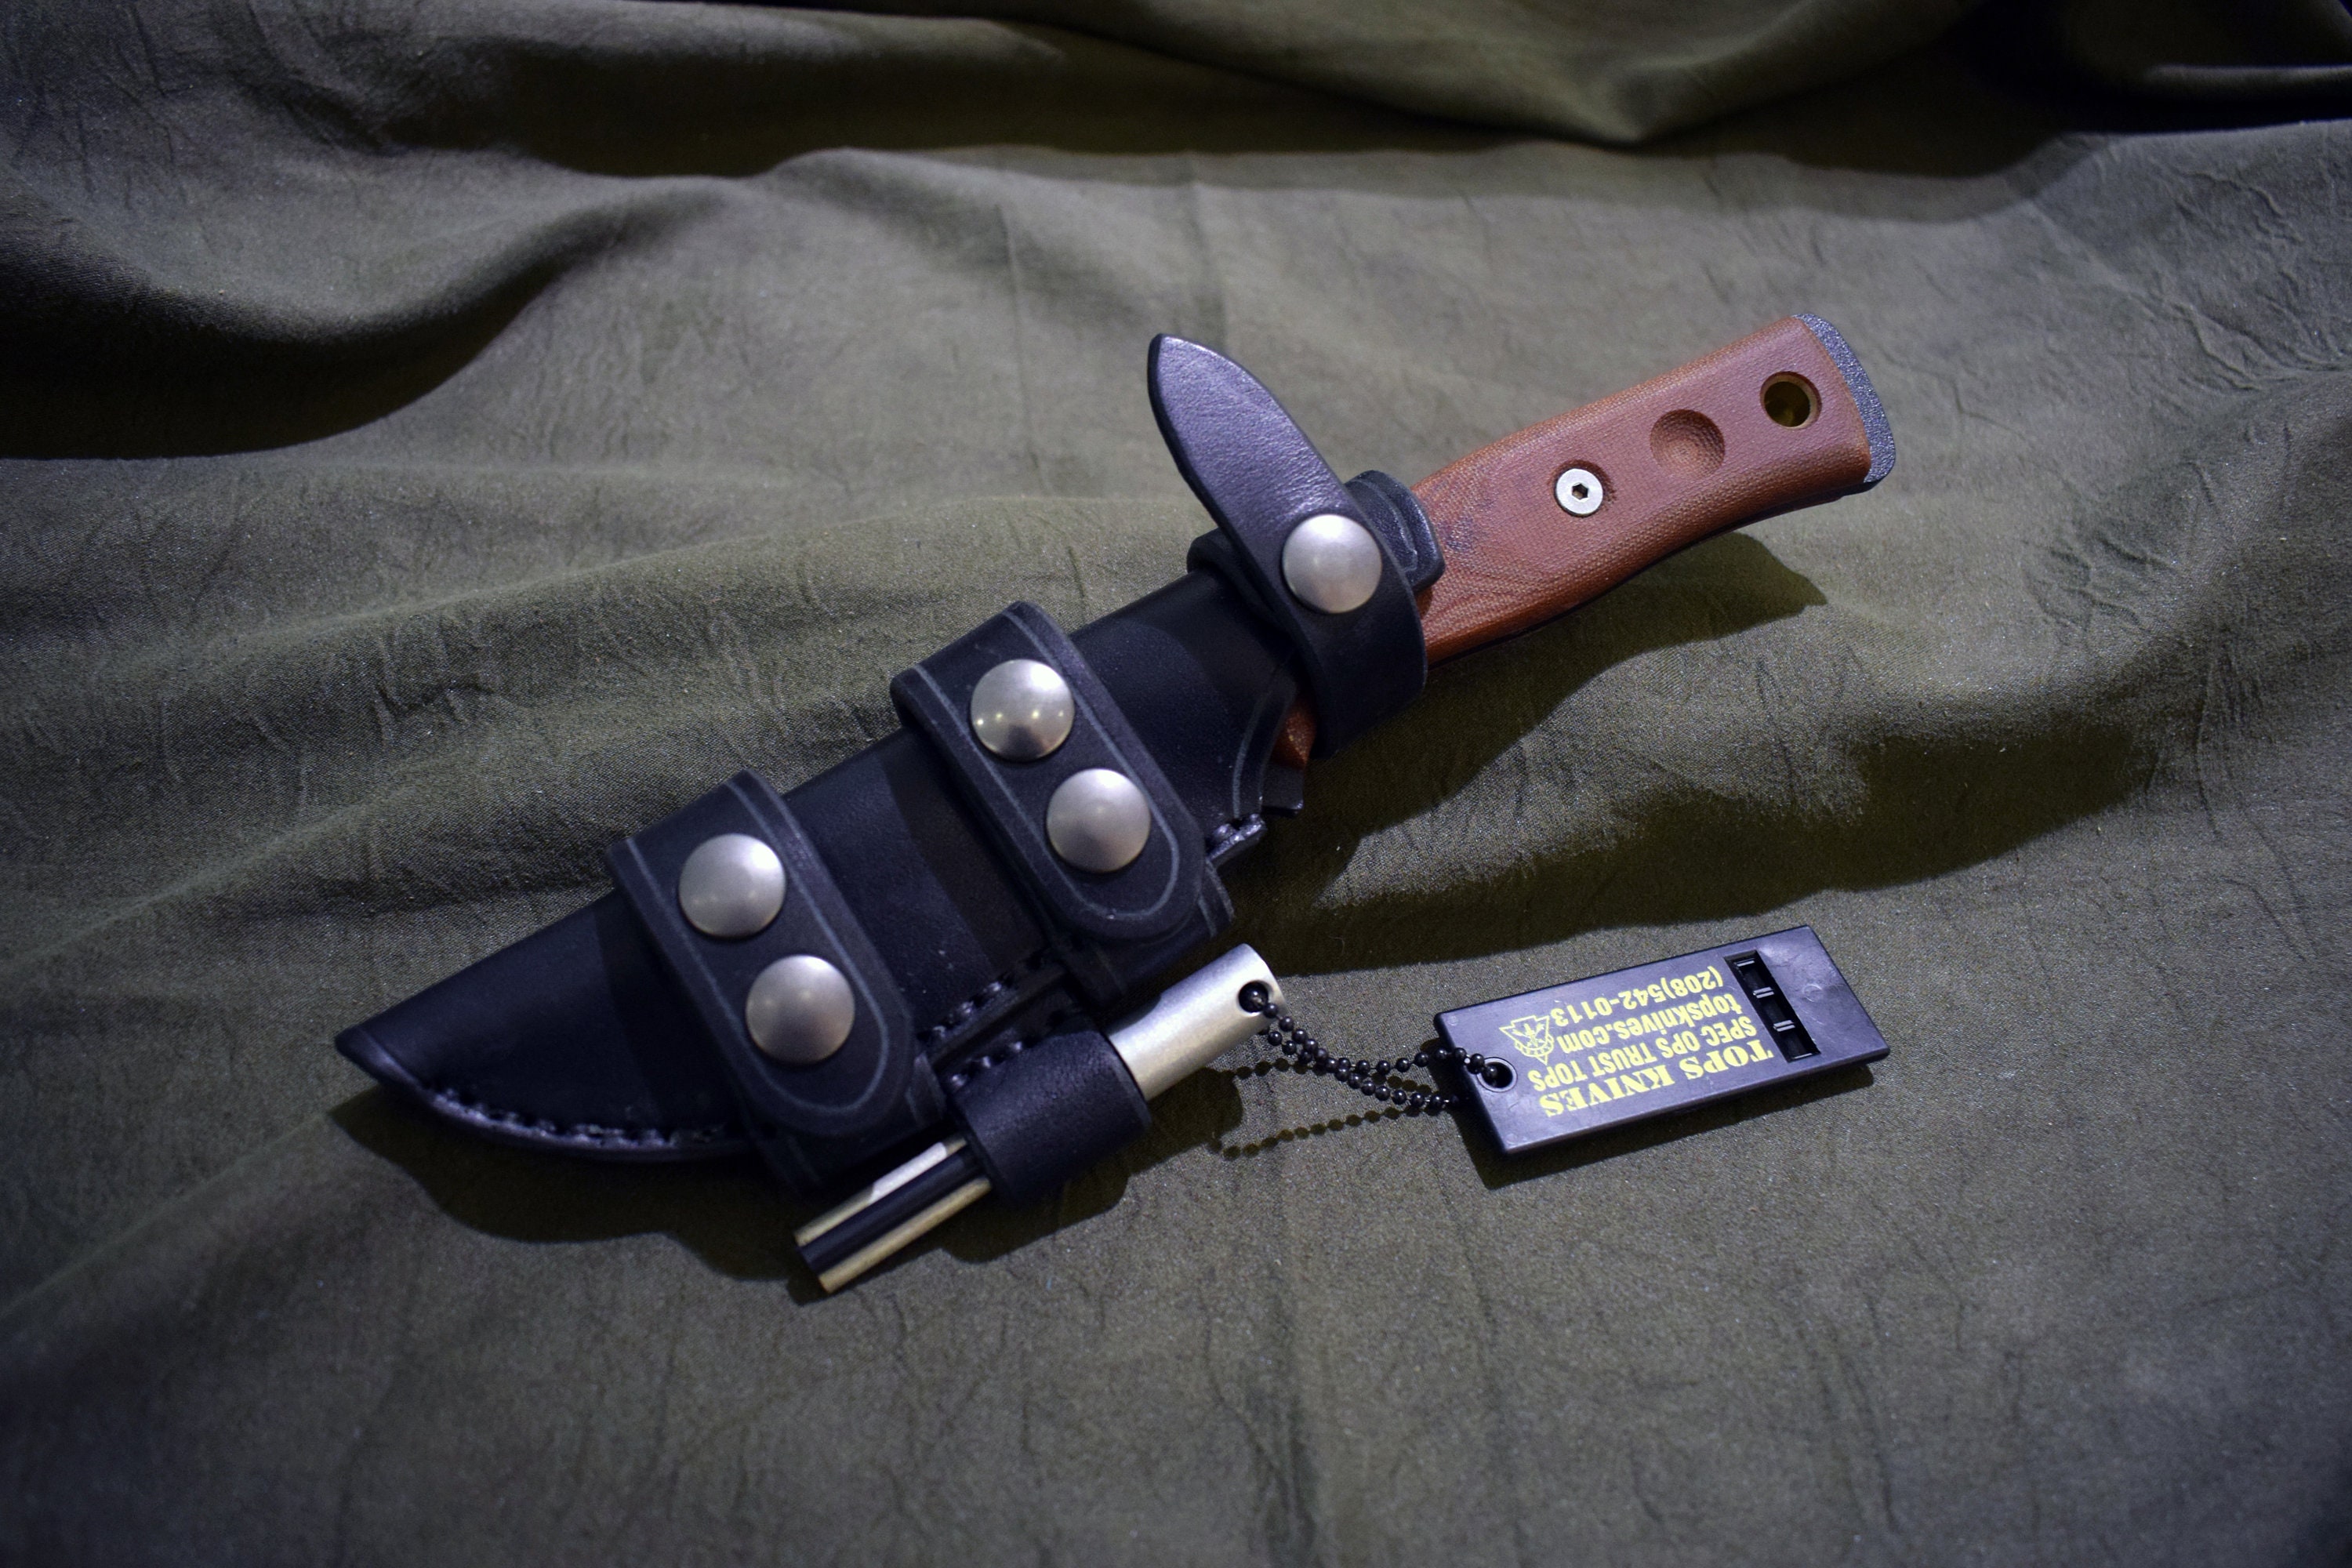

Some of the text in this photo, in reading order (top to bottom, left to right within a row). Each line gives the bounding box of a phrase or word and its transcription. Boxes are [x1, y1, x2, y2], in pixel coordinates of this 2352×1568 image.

[1551, 966, 1723, 1027] (208)542-0113
[1557, 994, 1742, 1053] topsknives.com
[1527, 1016, 1757, 1091] SPEC OPS TRUST TOPS
[1539, 1040, 1774, 1117] TOPS KNIVES
